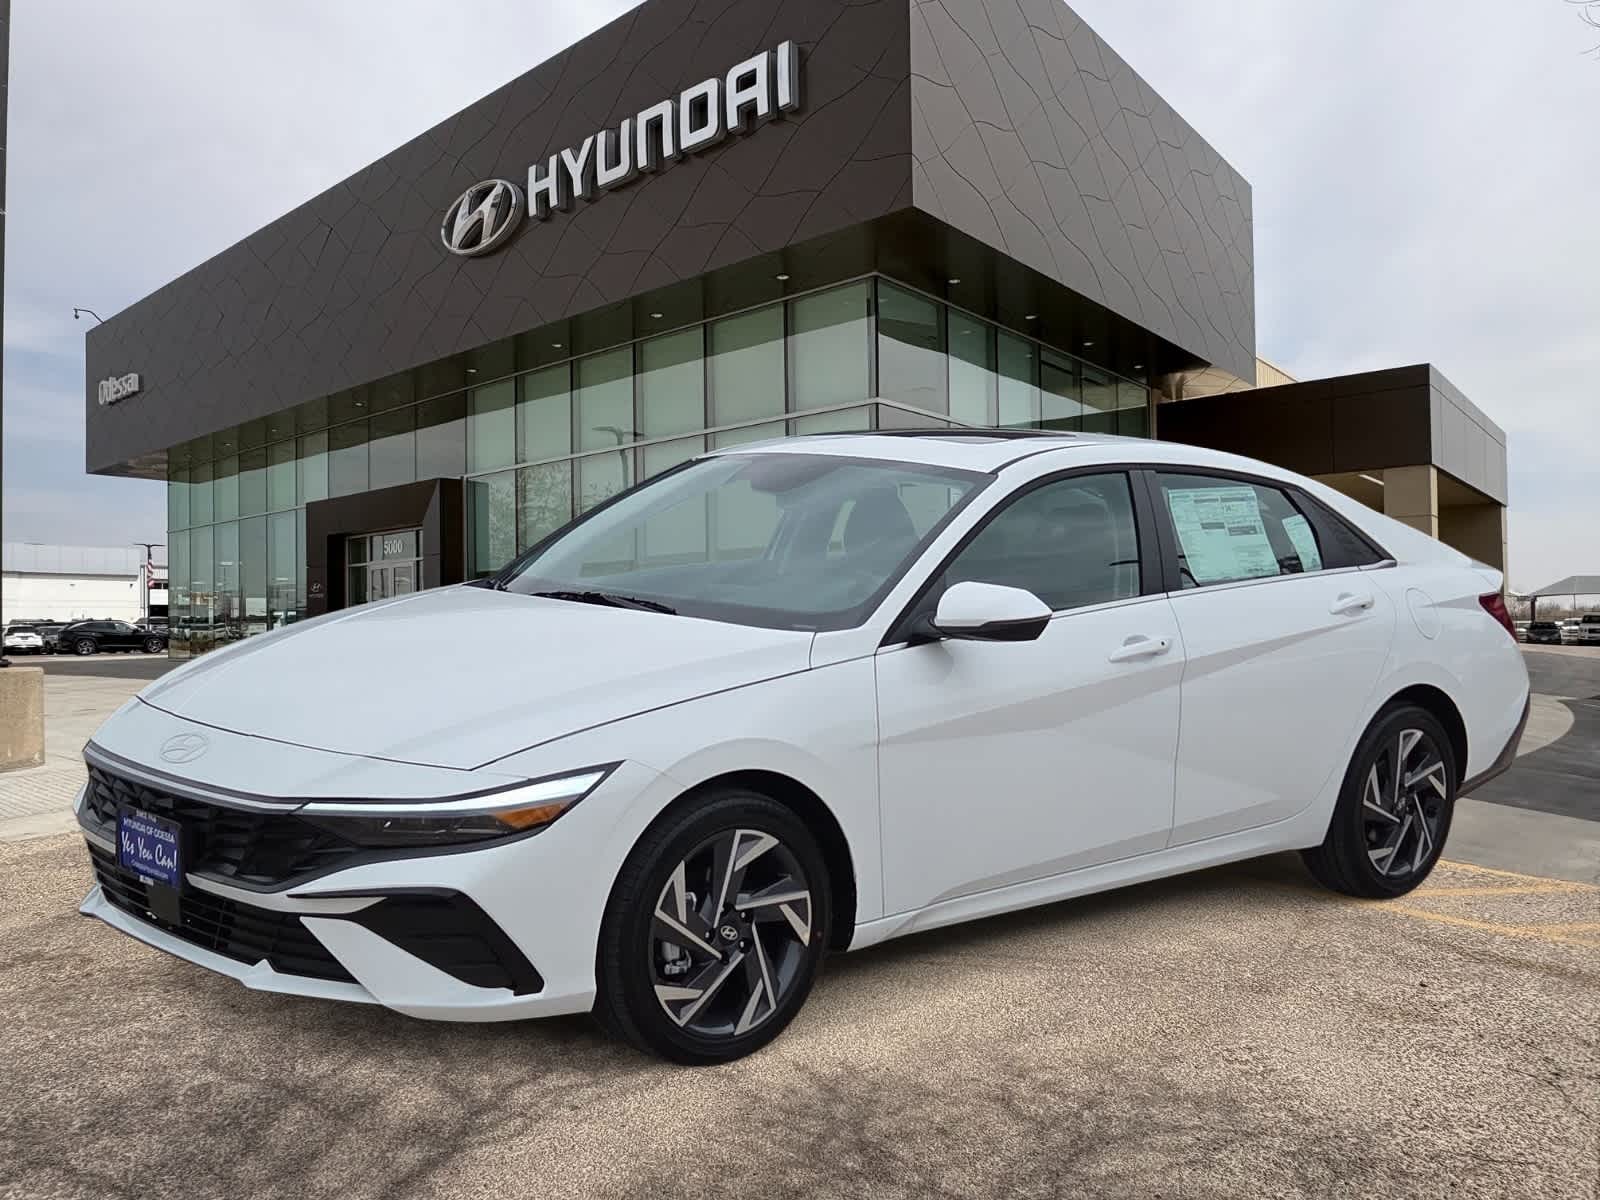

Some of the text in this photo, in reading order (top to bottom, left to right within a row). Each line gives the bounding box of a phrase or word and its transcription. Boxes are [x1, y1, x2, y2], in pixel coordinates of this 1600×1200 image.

[527, 40, 799, 219] HYUNDAI
[98, 372, 139, 405] Odessa
[383, 540, 403, 555] 5000
[121, 831, 135, 856] Yes
[137, 836, 153, 861] You
[155, 843, 177, 872] Can!
